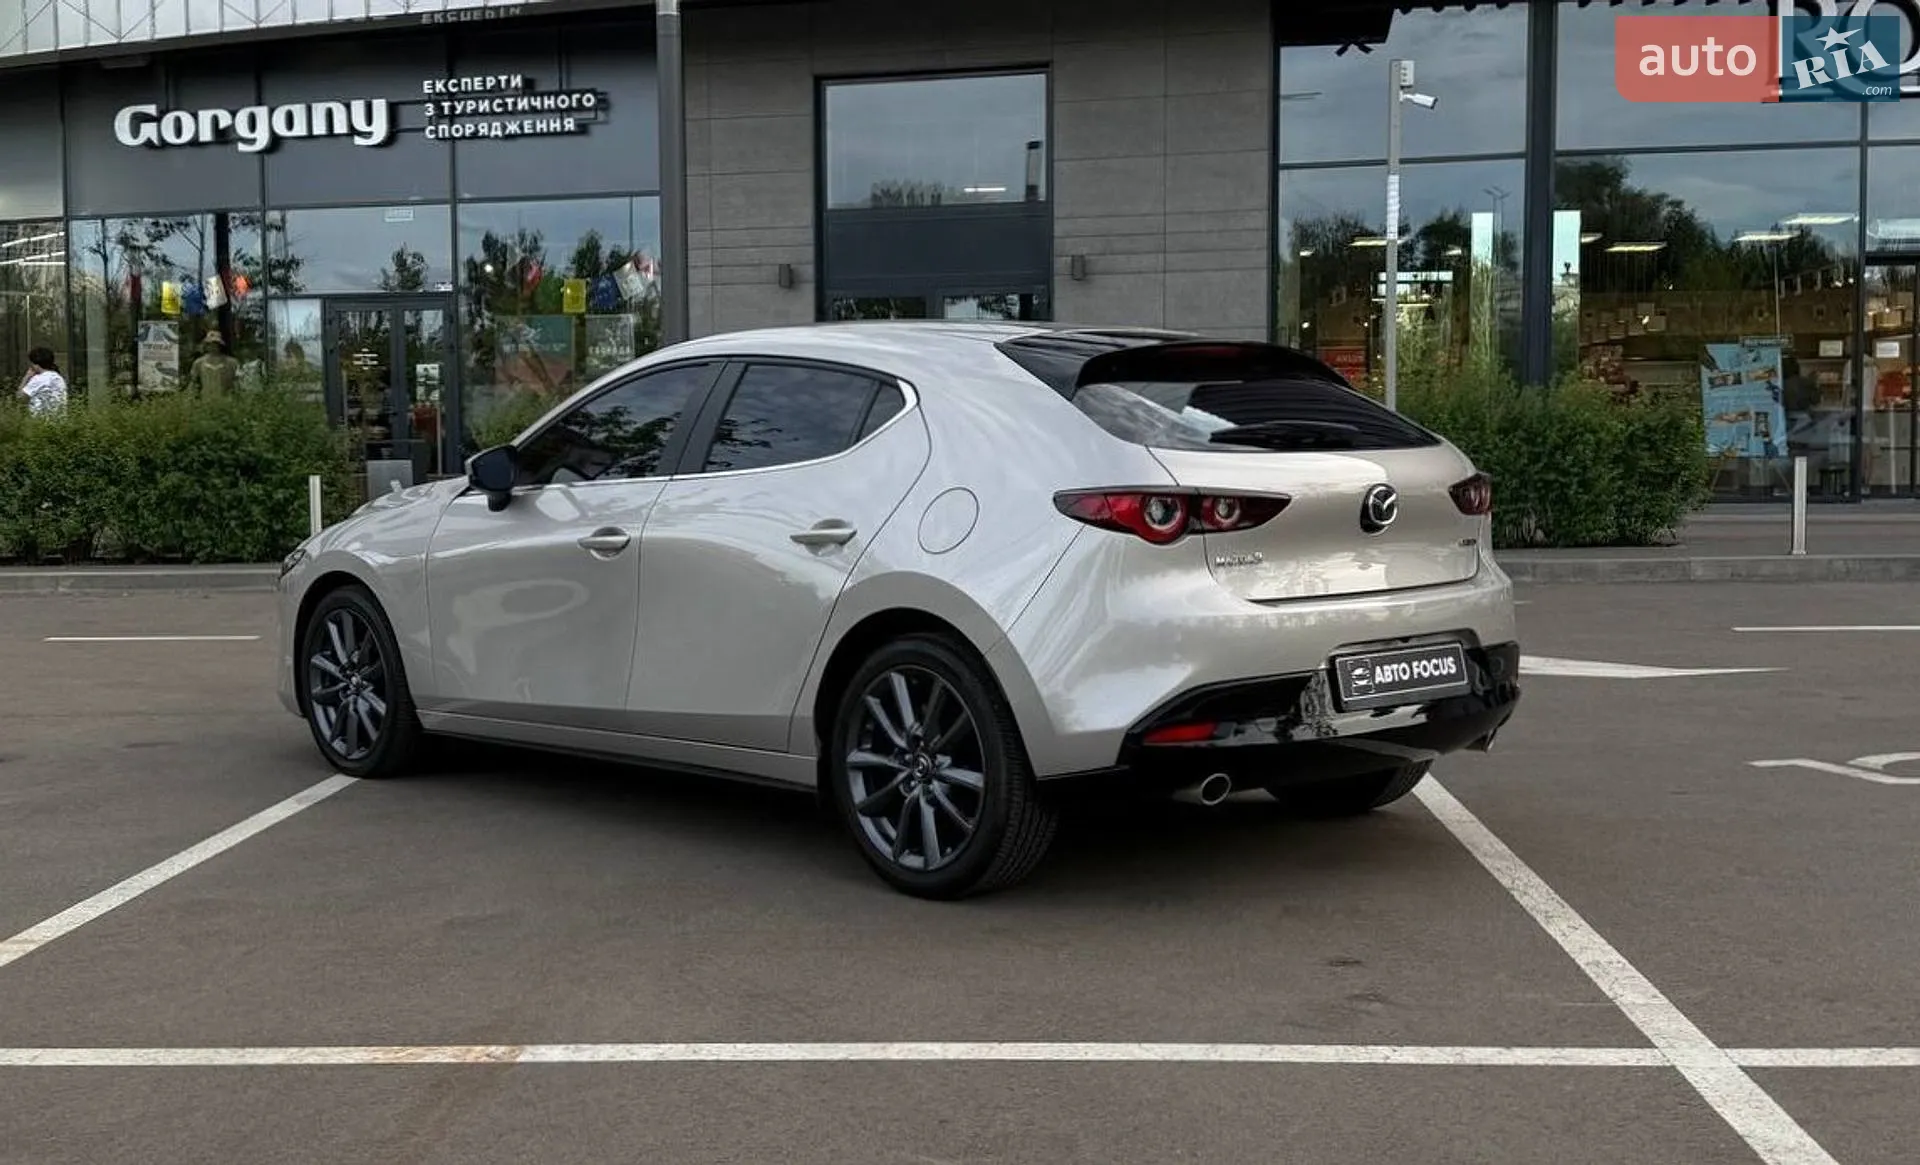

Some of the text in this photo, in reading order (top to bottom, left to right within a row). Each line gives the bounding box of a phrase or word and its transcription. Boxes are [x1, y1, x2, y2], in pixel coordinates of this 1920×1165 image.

[423, 74, 522, 94] ЕКСПЕРТИ
[424, 93, 595, 117] З ТУРИСТИЧНОГО
[114, 98, 388, 152] Gorgany
[425, 117, 575, 139] СПОРЯДЖЕННЯ
[1412, 656, 1456, 679] FOCUS
